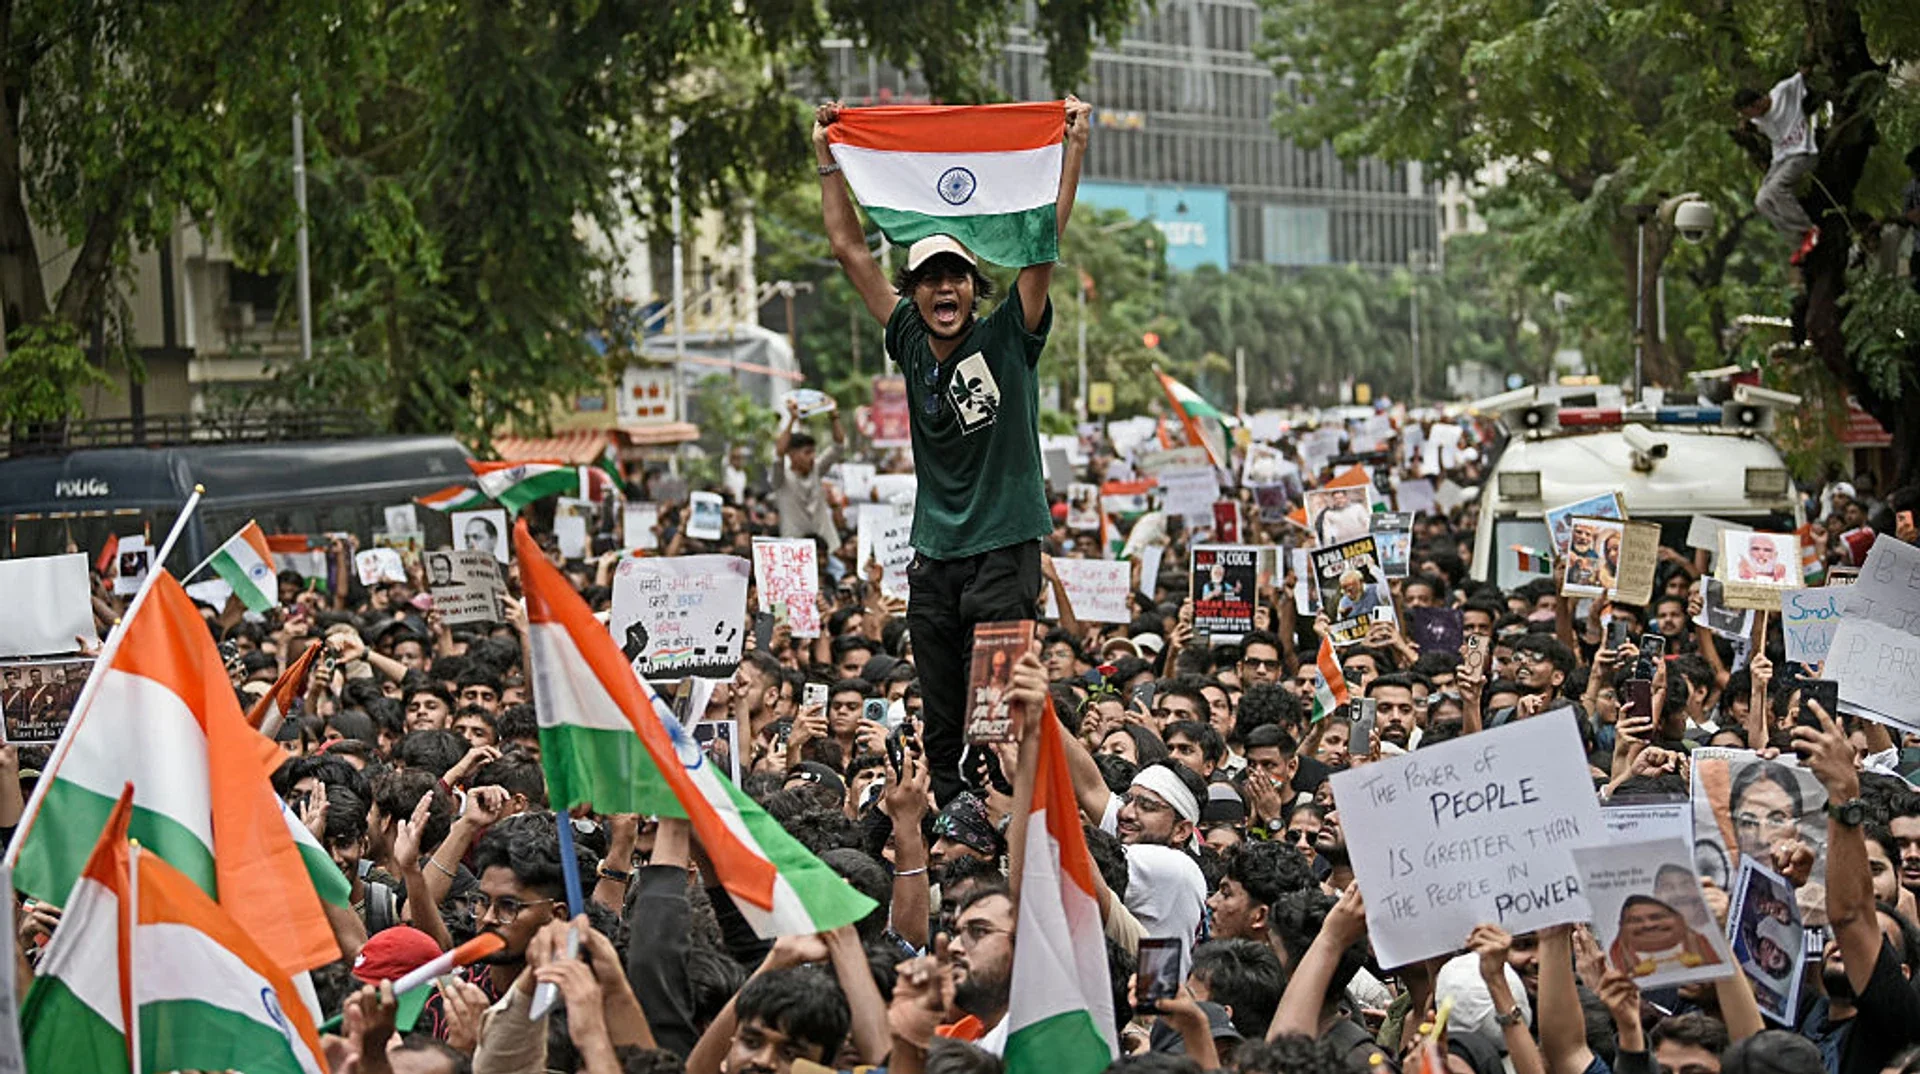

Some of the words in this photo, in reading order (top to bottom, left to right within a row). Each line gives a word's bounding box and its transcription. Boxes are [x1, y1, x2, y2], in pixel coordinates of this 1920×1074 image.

[1226, 552, 1252, 566] COOL
[1361, 774, 1396, 807] THE
[1404, 761, 1461, 792] POWER
[1429, 777, 1541, 827] PEOPLE
[1389, 848, 1413, 879] IS
[1423, 833, 1516, 870] GREATER
[1525, 816, 1580, 849] THAN
[1381, 893, 1420, 921] THE
[1425, 878, 1491, 909] PEOPLE
[1507, 862, 1528, 884] IN
[1494, 875, 1580, 924] POWER
